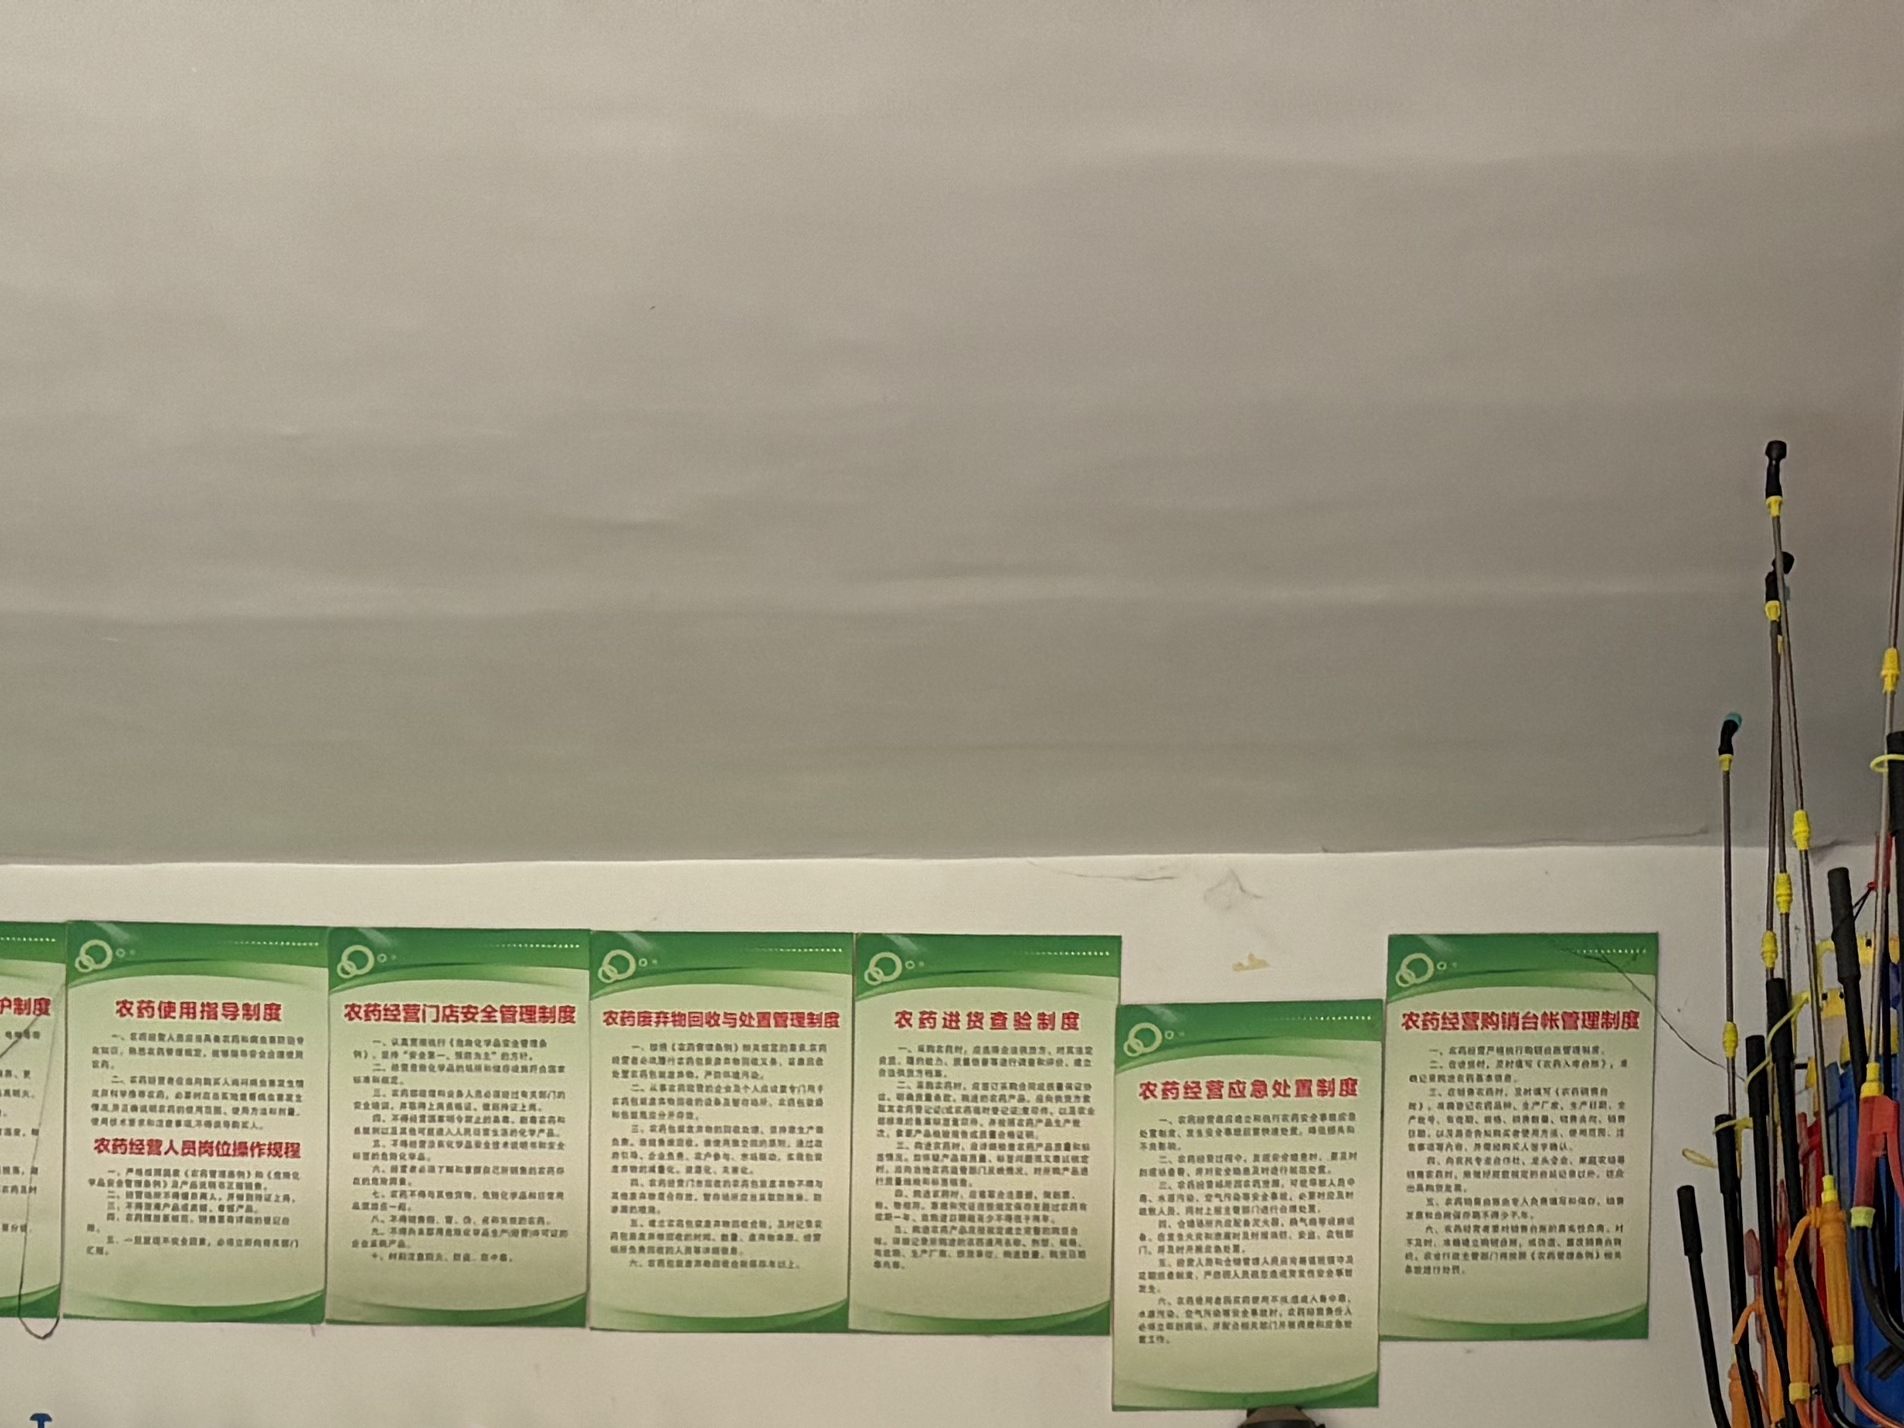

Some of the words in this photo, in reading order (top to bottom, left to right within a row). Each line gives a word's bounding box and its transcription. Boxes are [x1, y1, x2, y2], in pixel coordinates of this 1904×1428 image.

[115, 999, 283, 1022] 农药使用指导制度
[343, 1003, 577, 1024] 农药经营门店安全管理制度
[602, 1010, 841, 1028] 农药废弃物回收与处置管理制度
[893, 1009, 1081, 1031] 农药进货查验制度
[1400, 1010, 1641, 1032] 农药经营购销台帐管理制度
[1138, 1077, 1359, 1100] 农药经营应急处置制度
[93, 1138, 302, 1160] 农药经营人员岗位操作规程
